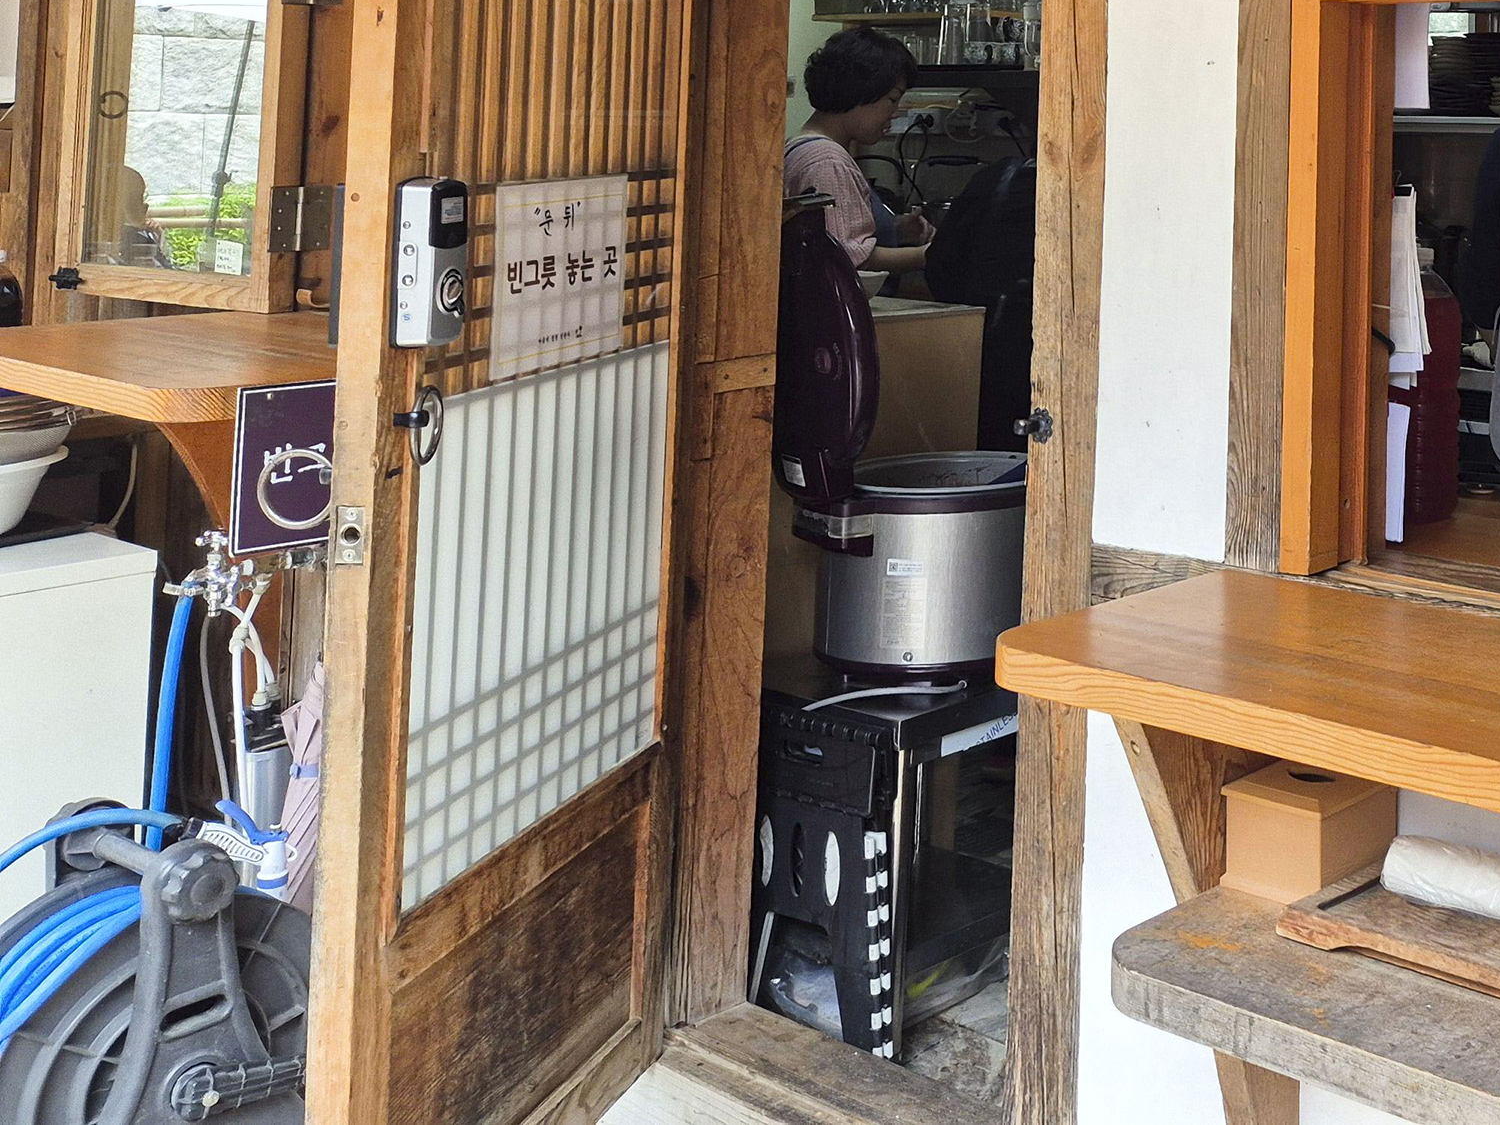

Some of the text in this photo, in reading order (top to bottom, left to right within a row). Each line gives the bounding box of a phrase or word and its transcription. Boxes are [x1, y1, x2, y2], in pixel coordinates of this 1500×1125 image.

[507, 245, 618, 295] 빈그릇 놓는 곳
